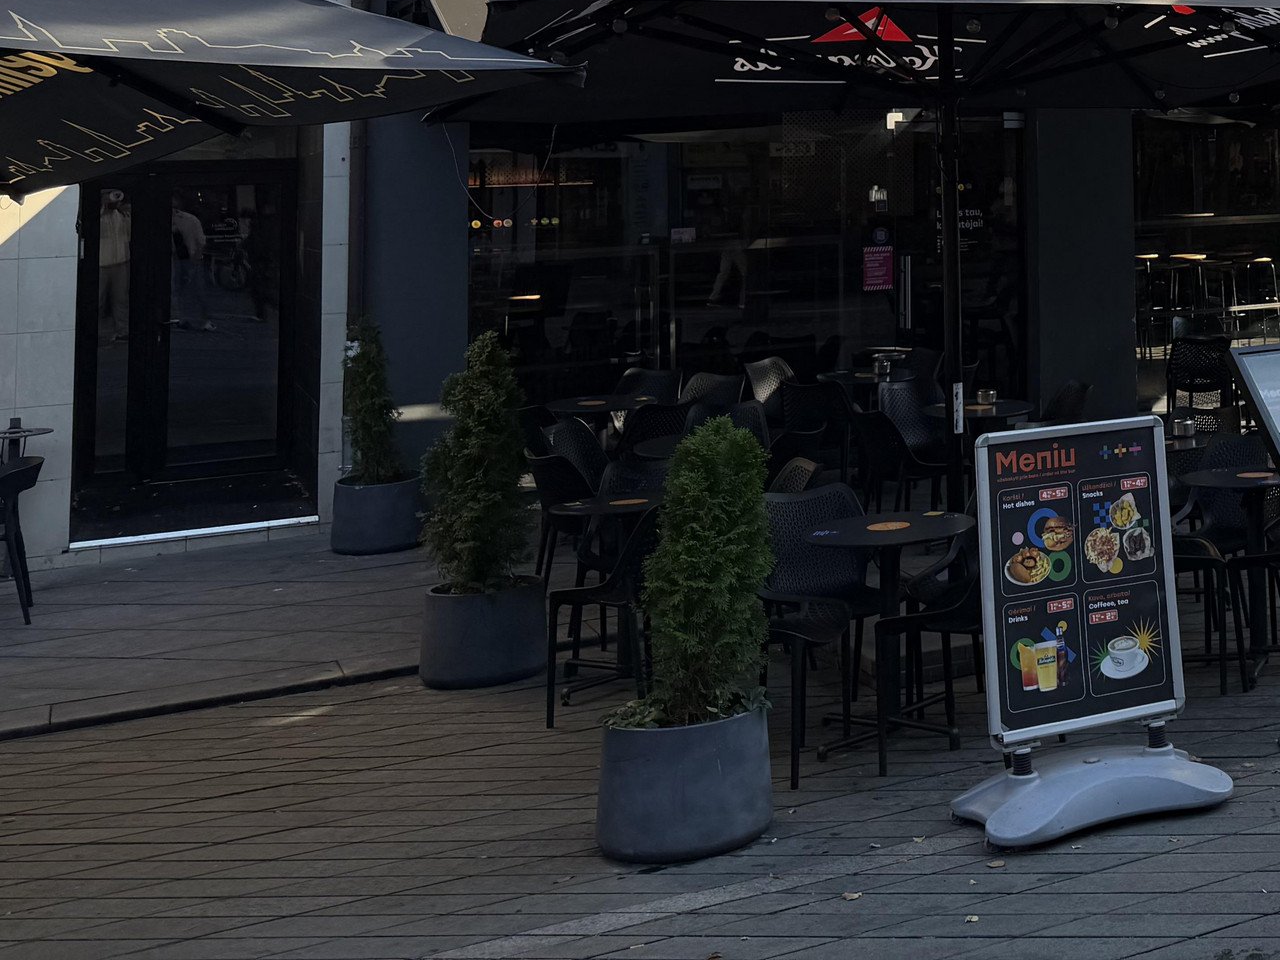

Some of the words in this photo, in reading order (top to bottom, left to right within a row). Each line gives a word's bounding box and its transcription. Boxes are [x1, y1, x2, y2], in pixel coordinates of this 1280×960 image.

[996, 443, 1075, 475] Meniu
[1016, 500, 1035, 508] dishes
[1008, 615, 1028, 623] Drinks
